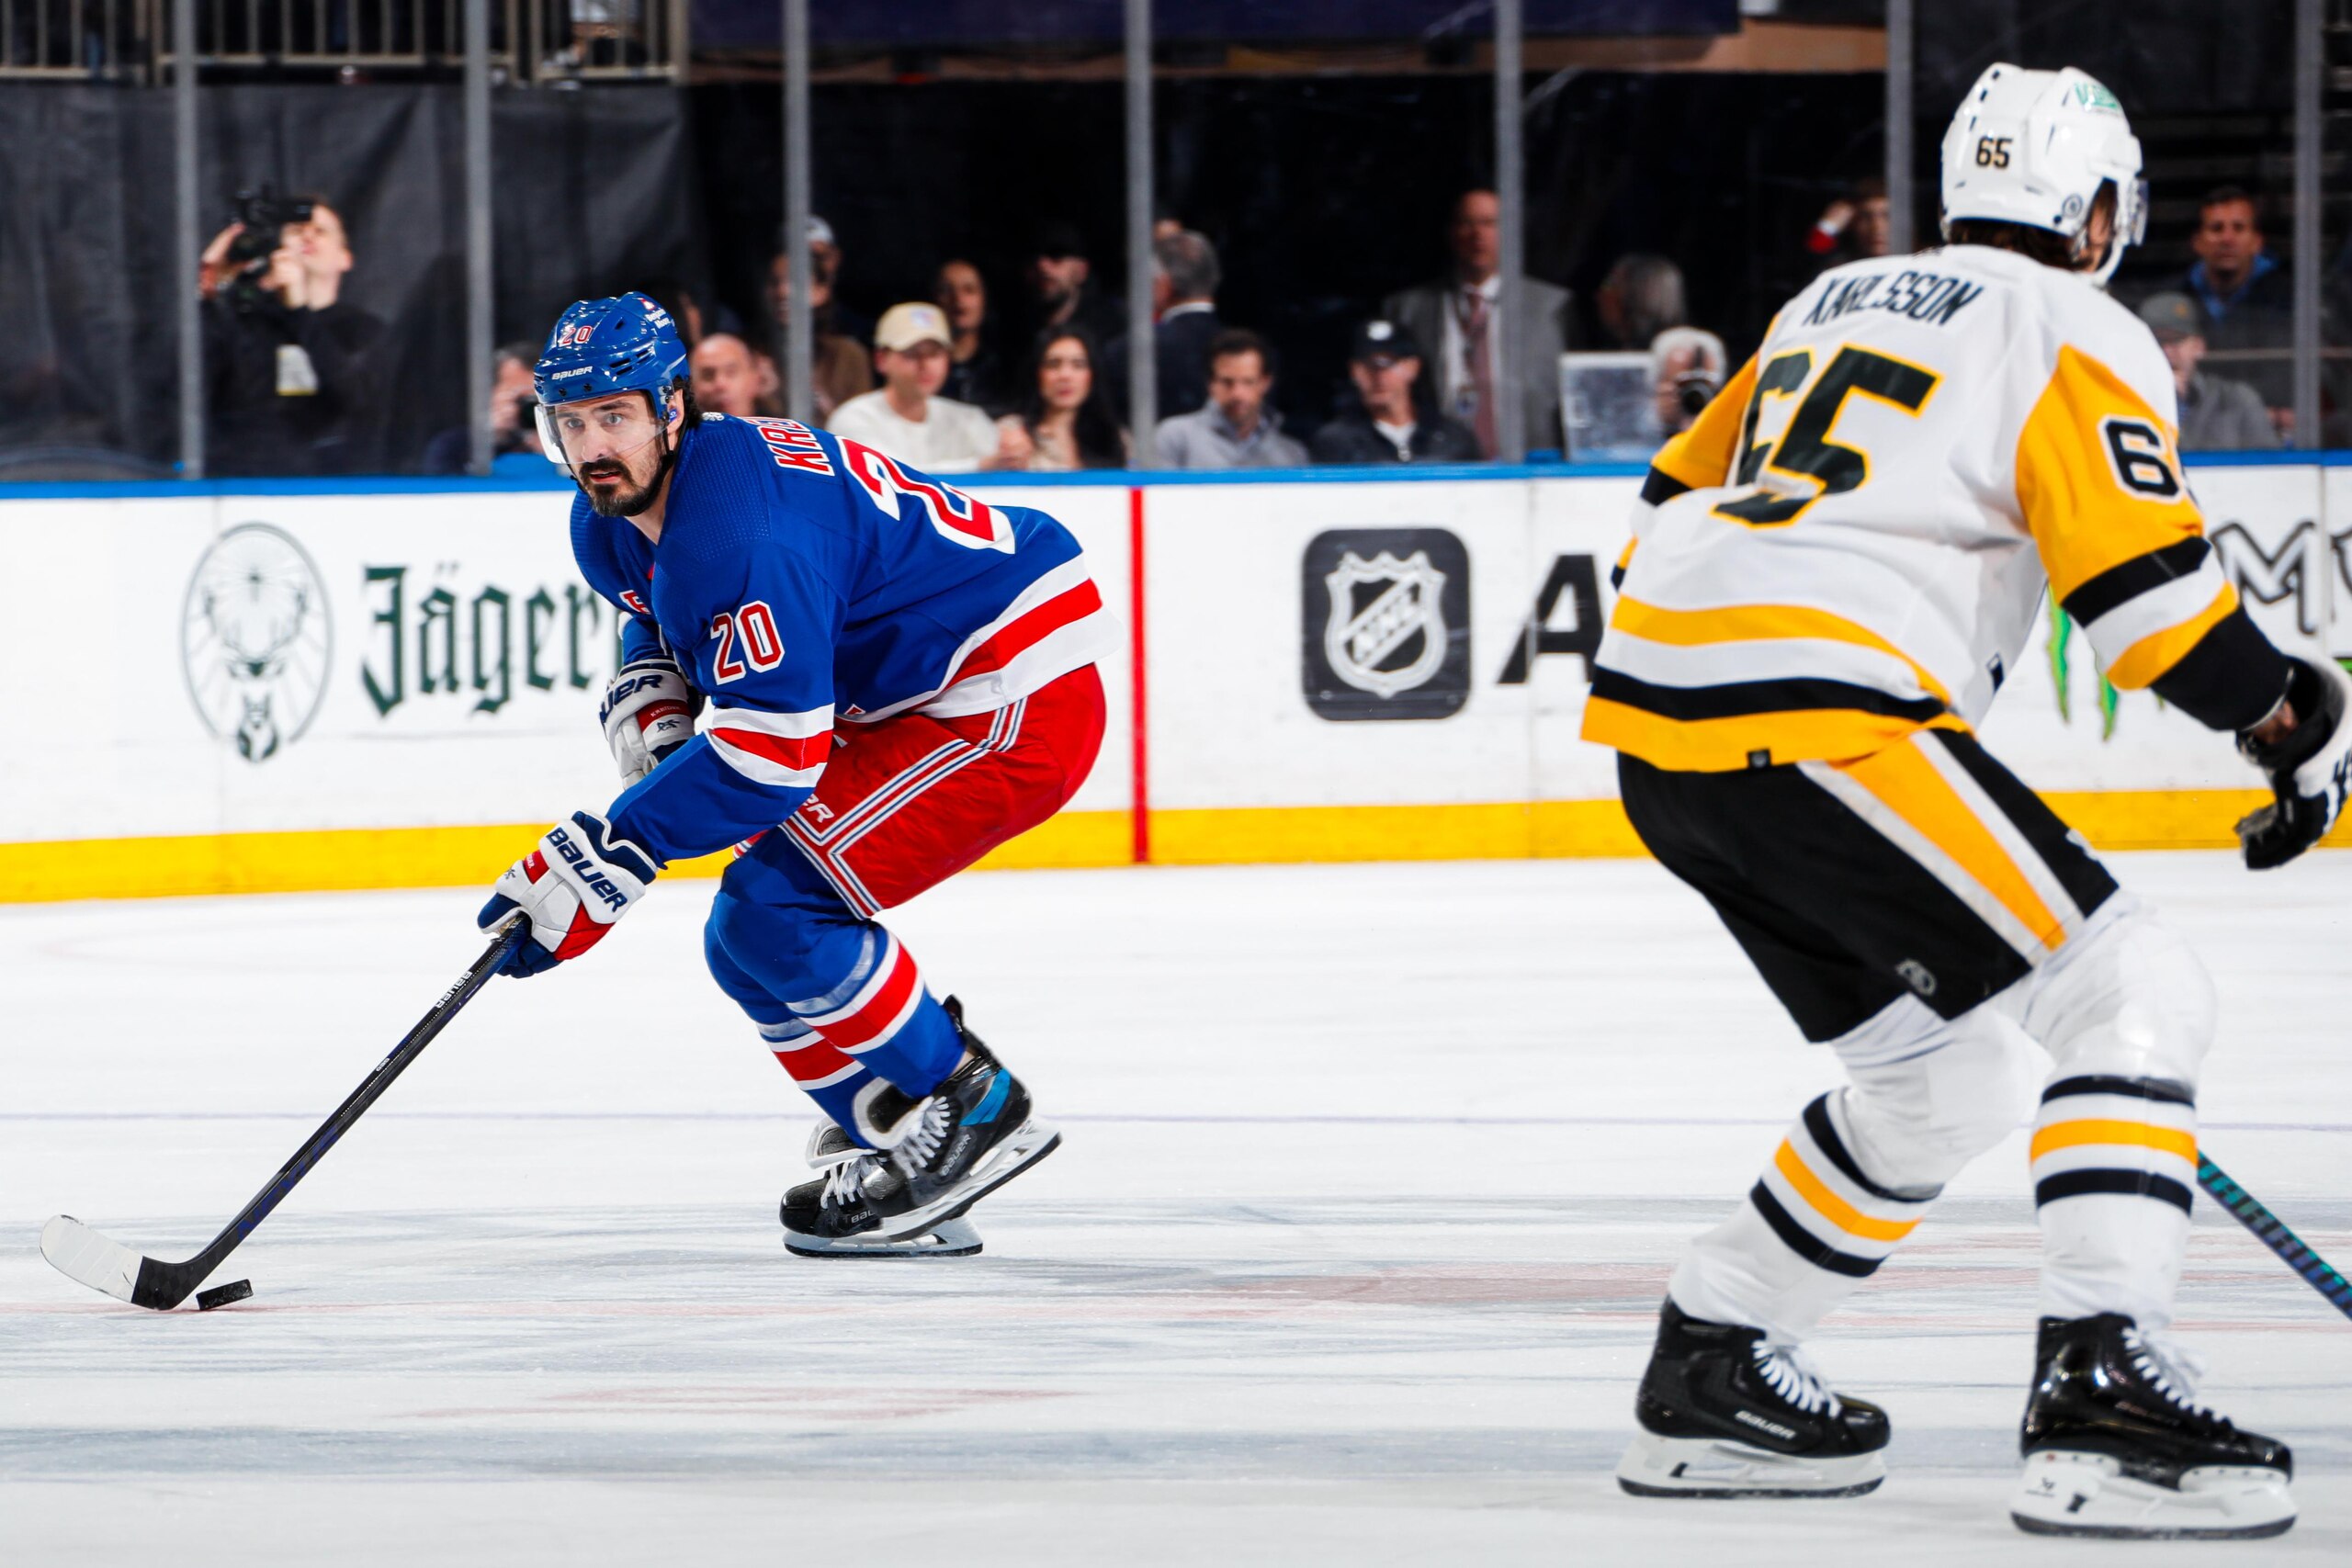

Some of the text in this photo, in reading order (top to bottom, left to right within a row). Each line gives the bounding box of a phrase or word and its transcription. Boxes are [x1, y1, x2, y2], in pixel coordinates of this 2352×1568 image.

[1975, 136, 2012, 168] 65
[558, 325, 593, 346] 20
[551, 366, 593, 381] BAUER
[1710, 342, 1945, 531] 65
[2098, 413, 2194, 503] 6
[361, 561, 623, 719] Jäger
[710, 600, 786, 685] 20
[546, 827, 628, 912] BAUER
[435, 969, 473, 1009] BAUER
[940, 1134, 971, 1177] BAUER
[1735, 1409, 1796, 1439] BAUER
